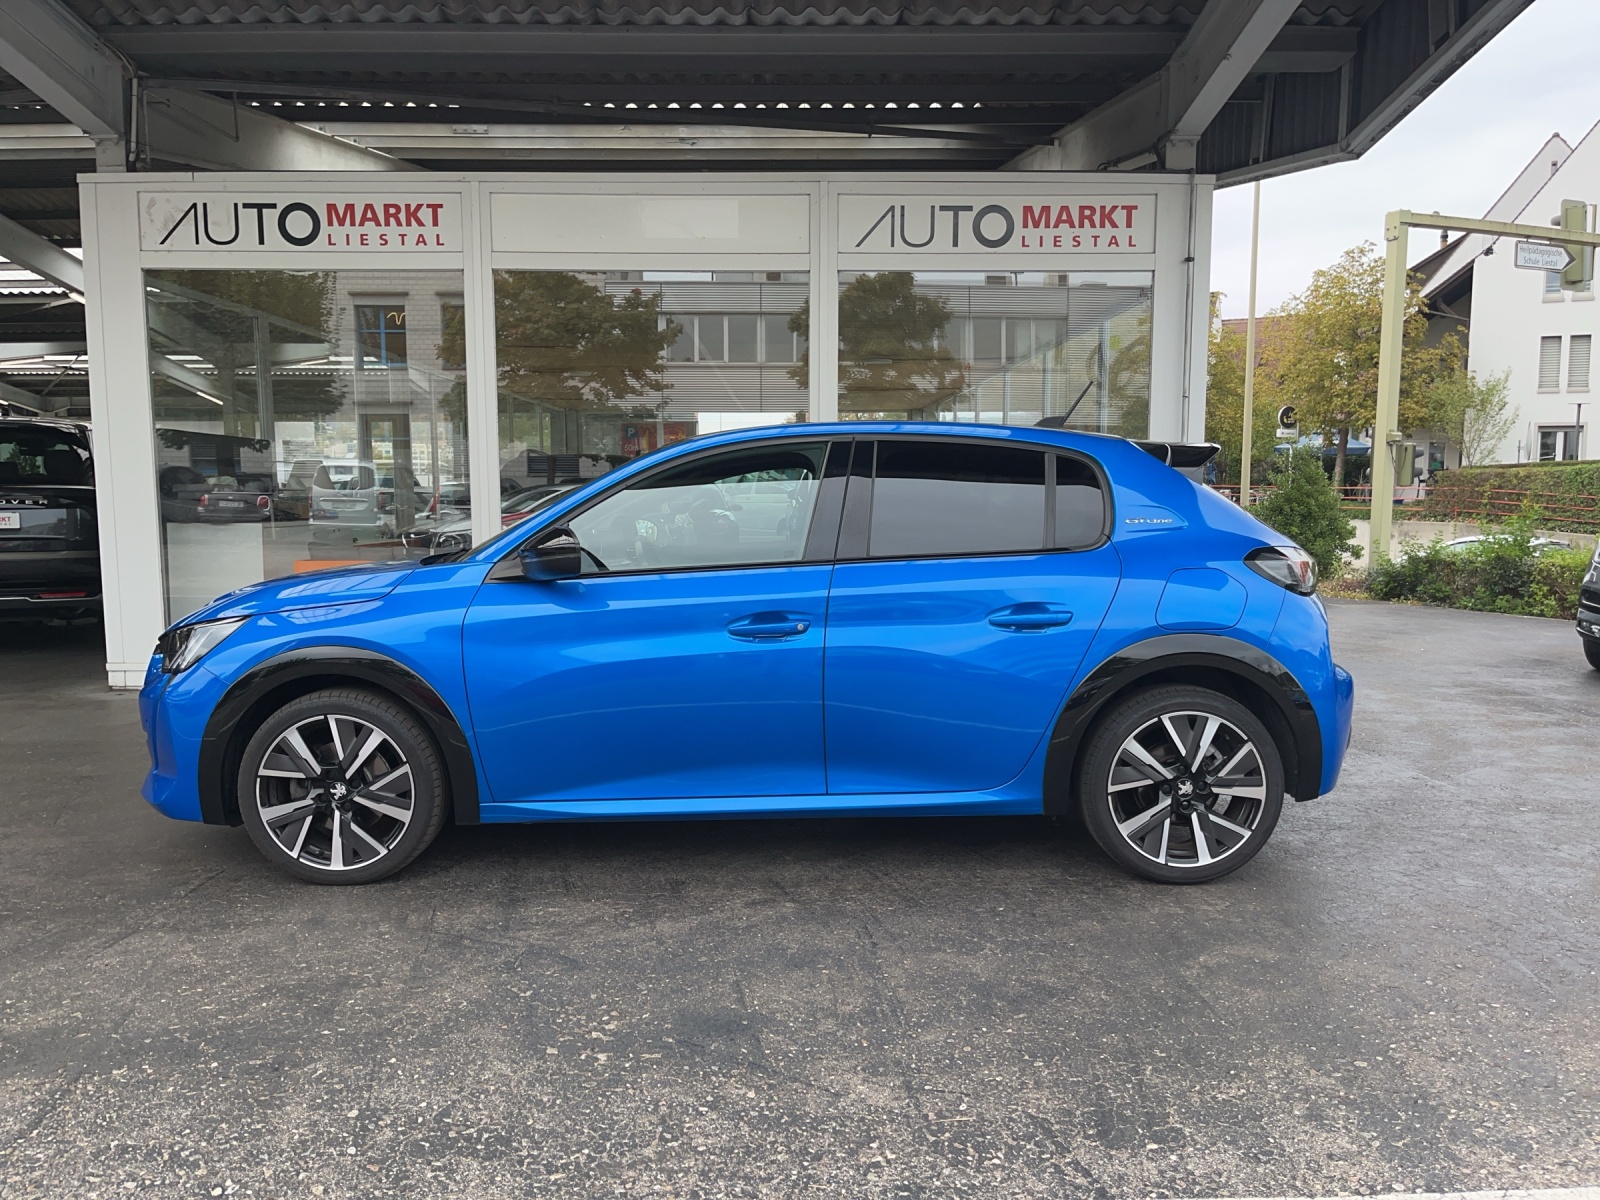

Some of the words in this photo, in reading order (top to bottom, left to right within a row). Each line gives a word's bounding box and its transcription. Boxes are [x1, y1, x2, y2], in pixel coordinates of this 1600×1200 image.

[159, 202, 321, 246] AUTO
[326, 203, 444, 227] MARKT
[855, 204, 1015, 248] AUTO
[1022, 205, 1138, 229] MARKT
[327, 233, 445, 246] LIESTAL
[1021, 235, 1137, 247] LIESTAL
[1519, 245, 1562, 258] Heilpädagogische
[1523, 256, 1540, 266] Schule
[1541, 258, 1557, 267] Liestal
